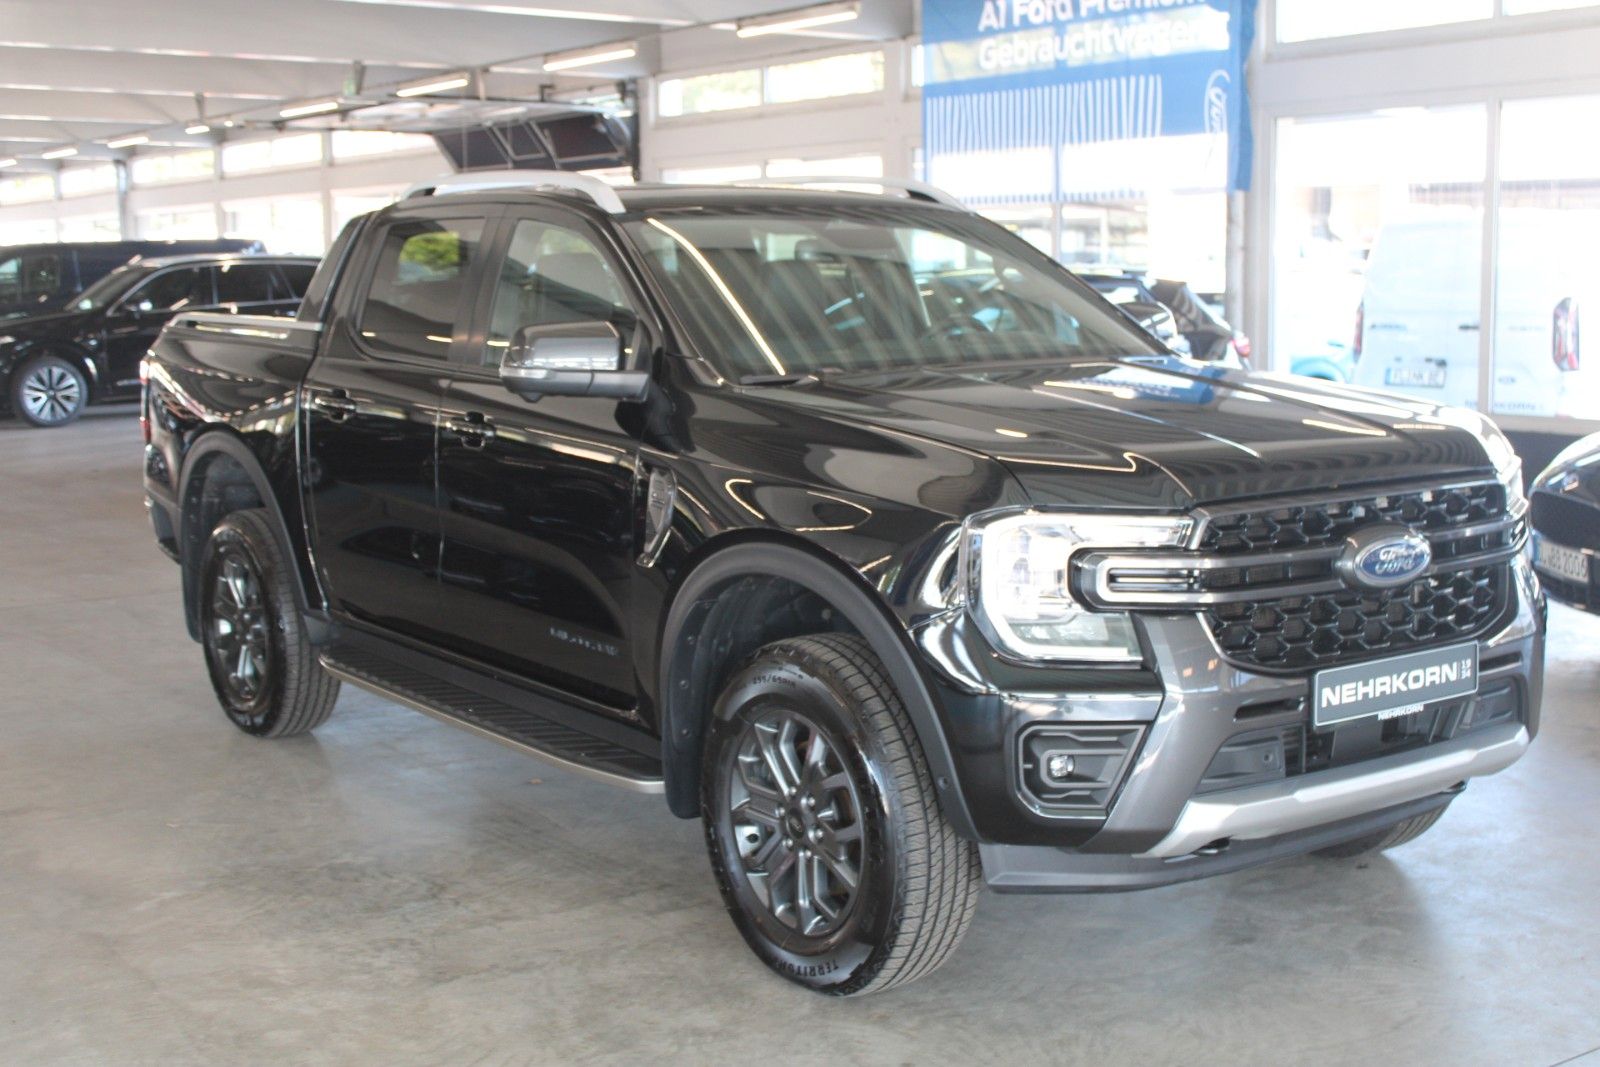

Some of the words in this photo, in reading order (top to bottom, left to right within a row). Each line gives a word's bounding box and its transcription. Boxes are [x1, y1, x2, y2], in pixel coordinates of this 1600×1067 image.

[1012, 0, 1073, 27] Ford
[978, 18, 1207, 70] Gebrauchtwage
[1375, 545, 1418, 574] Ford
[1321, 661, 1458, 708] NEHRKORN
[1377, 703, 1425, 721] NEHRKORN
